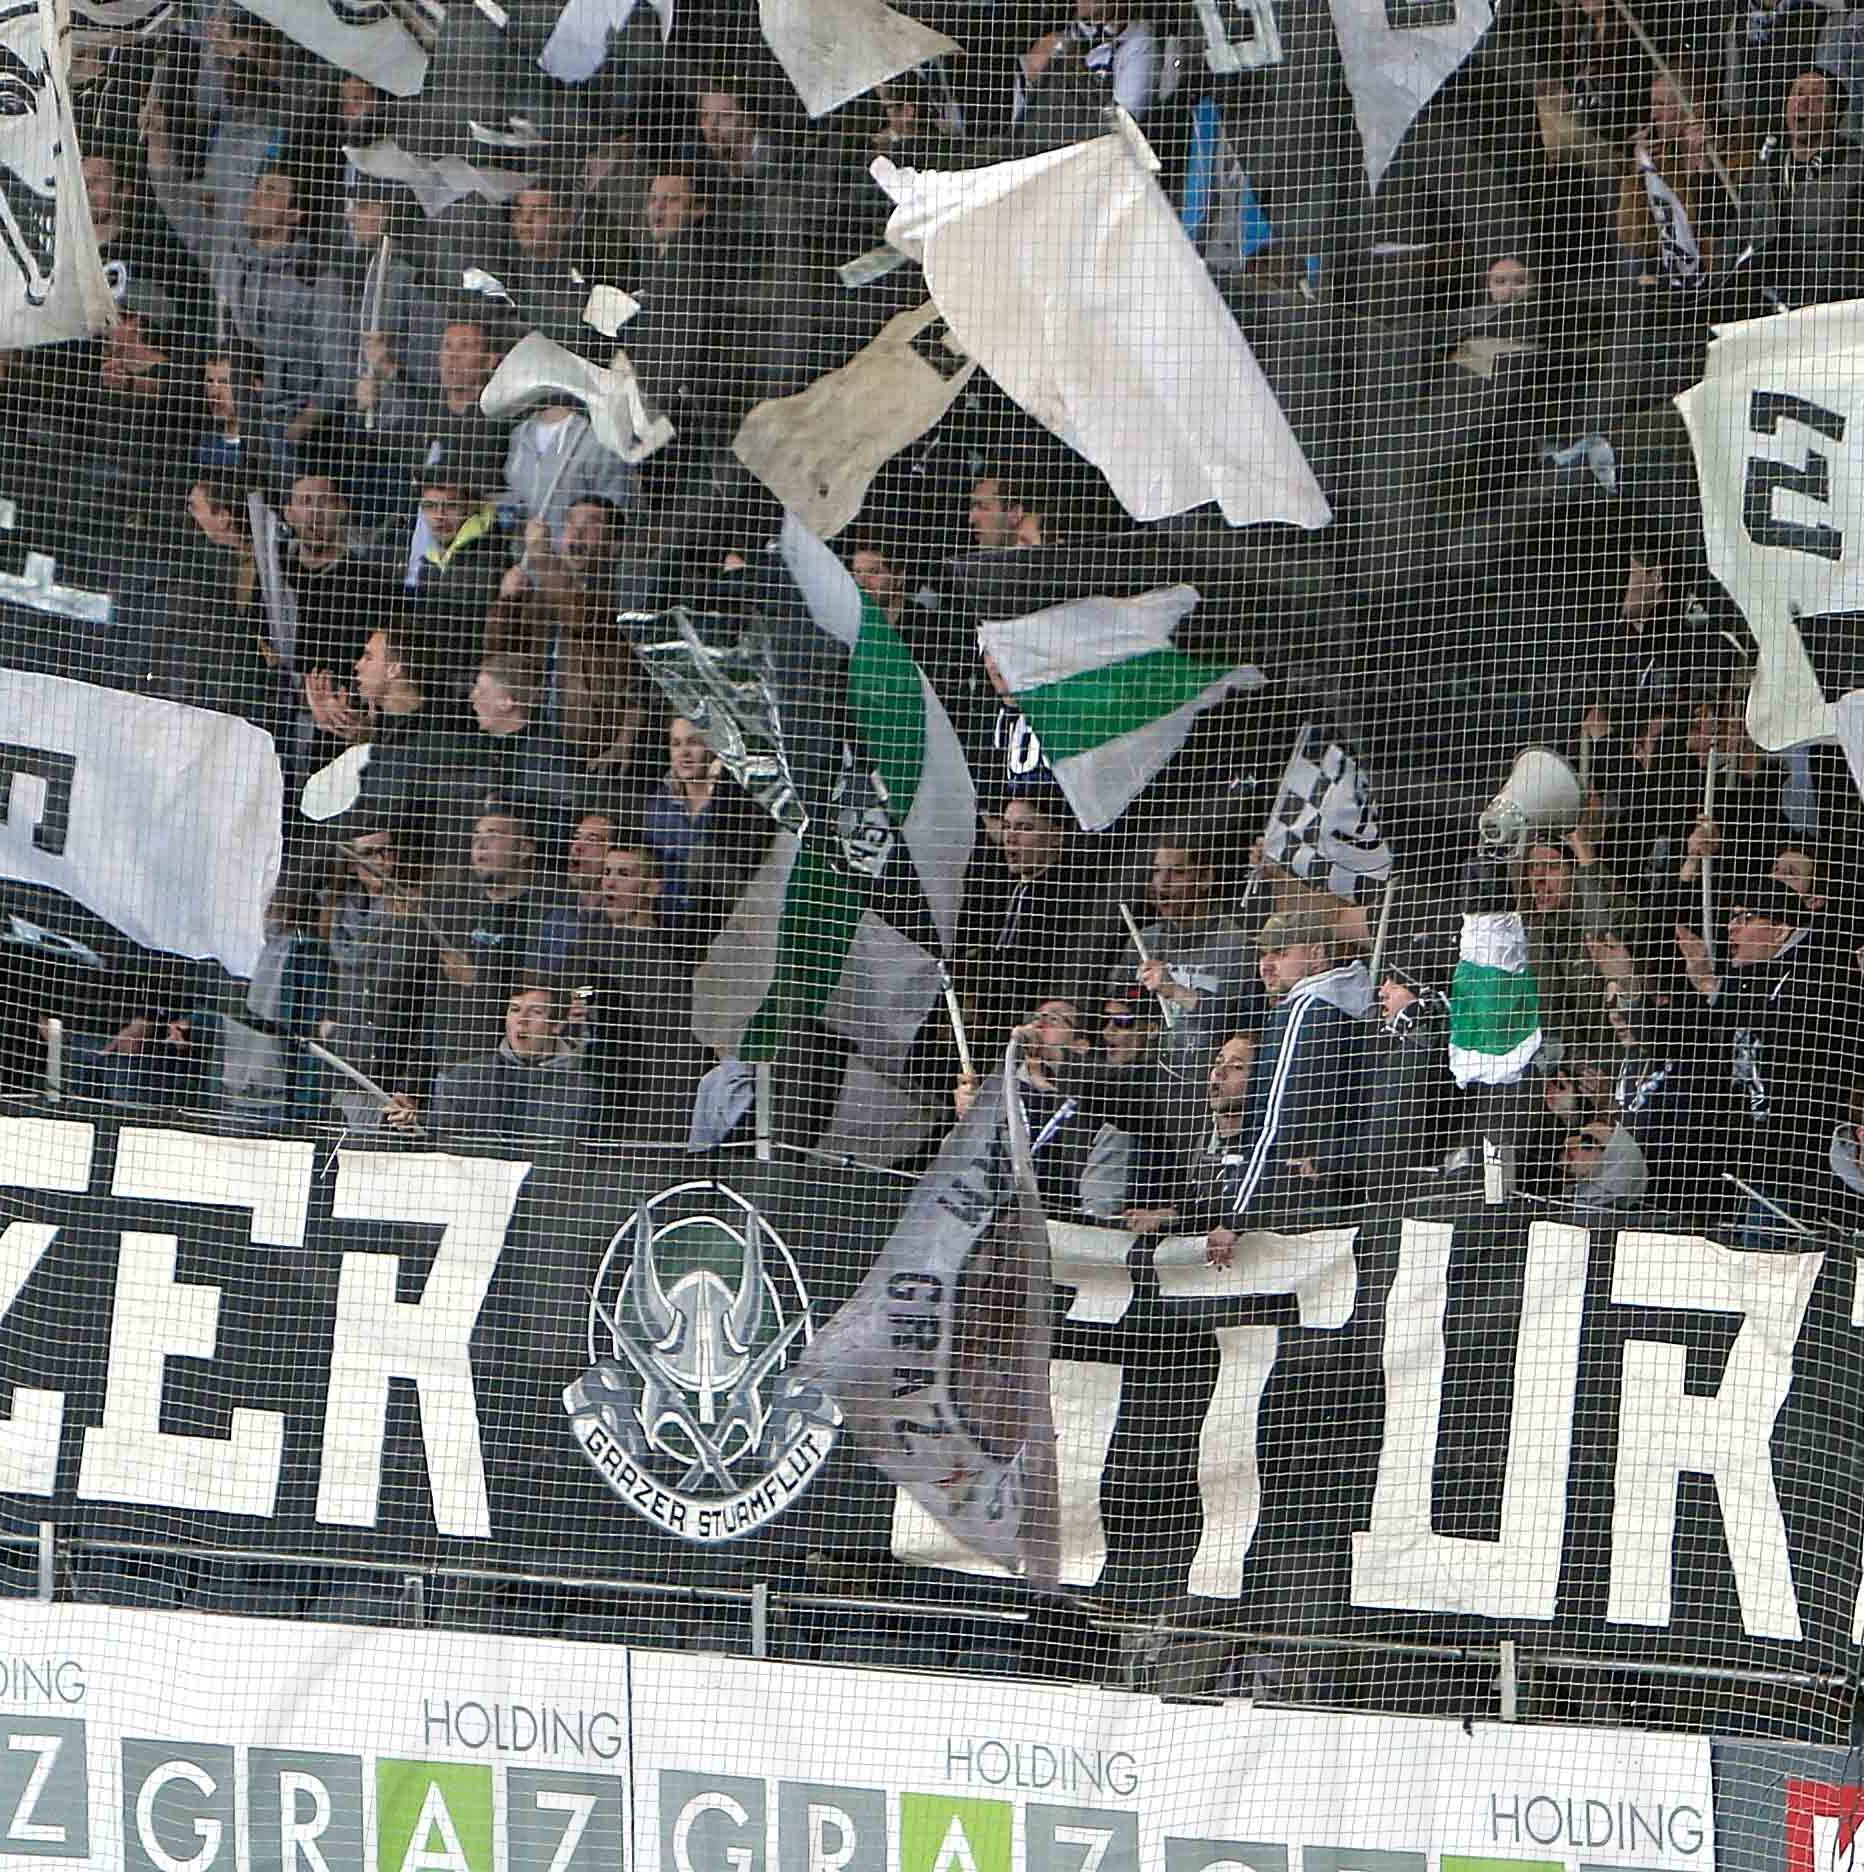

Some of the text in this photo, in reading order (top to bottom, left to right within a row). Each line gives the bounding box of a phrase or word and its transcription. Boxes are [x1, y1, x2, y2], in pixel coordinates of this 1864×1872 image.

[585, 1427, 824, 1538] GRAZER STURMFLUT
[422, 1699, 623, 1761] HOLDING
[946, 1739, 1140, 1796] HOLDING
[1490, 1794, 1706, 1857] HOLDING
